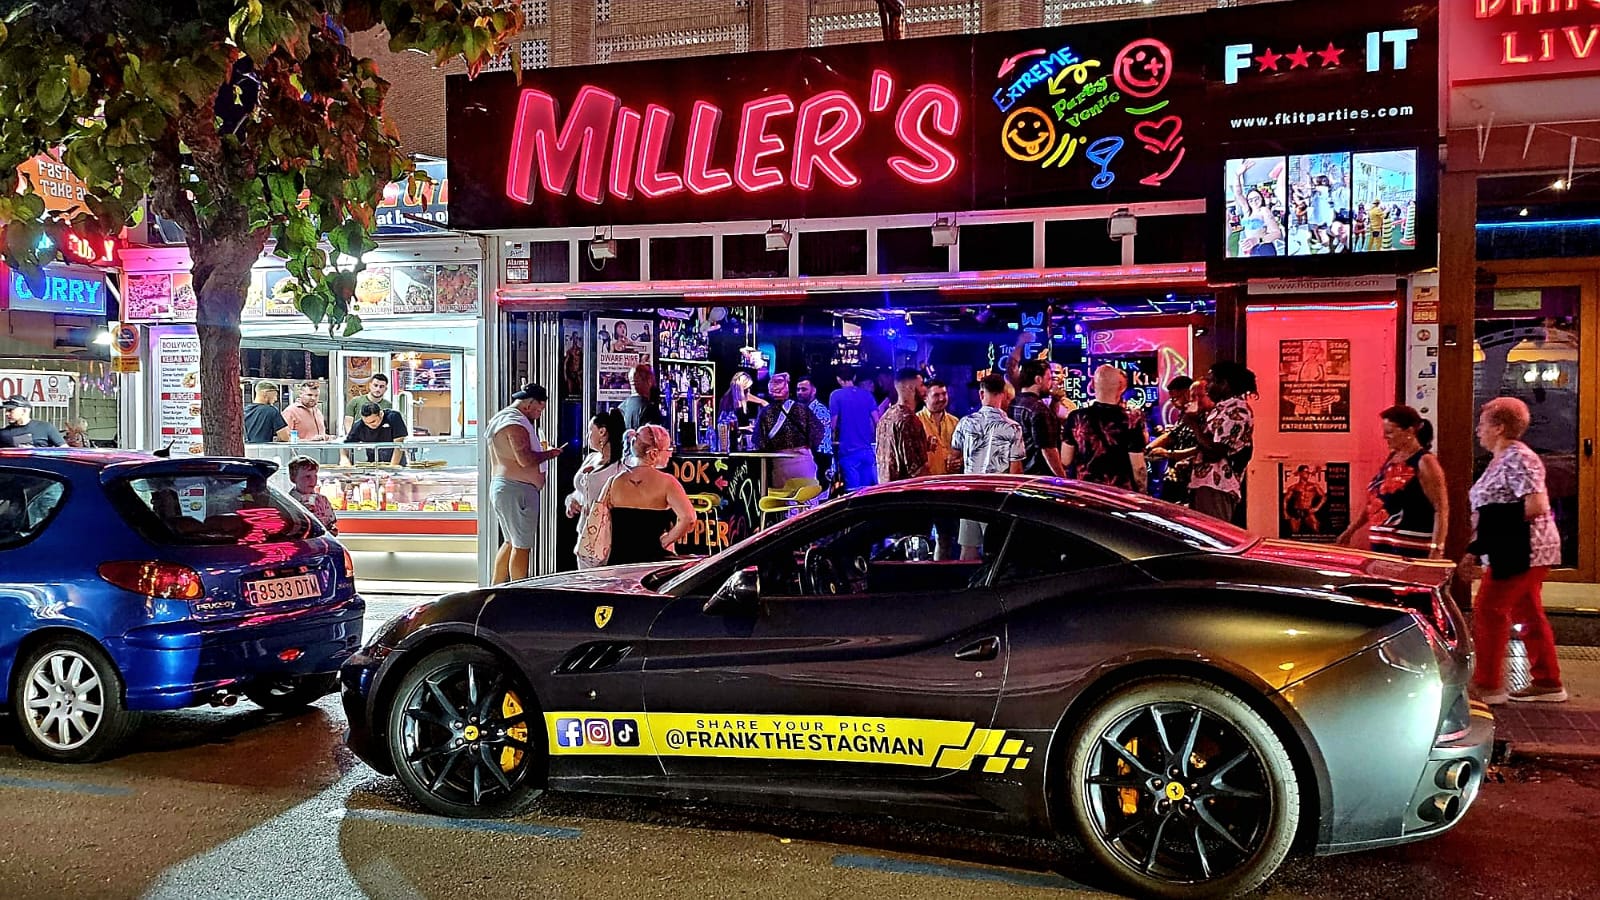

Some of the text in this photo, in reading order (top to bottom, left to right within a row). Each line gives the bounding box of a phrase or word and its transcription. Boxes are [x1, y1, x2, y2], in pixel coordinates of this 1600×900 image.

[1366, 28, 1418, 73] IT
[1052, 76, 1109, 121] Party
[1230, 104, 1414, 129] www.fkitparties.com
[506, 69, 961, 204] MILLER'S
[376, 212, 393, 225] at
[260, 581, 293, 600] 8533
[696, 719, 886, 733] SHARE YOUR PICS
[665, 728, 924, 756] @FRANKTHESTAGMAN
